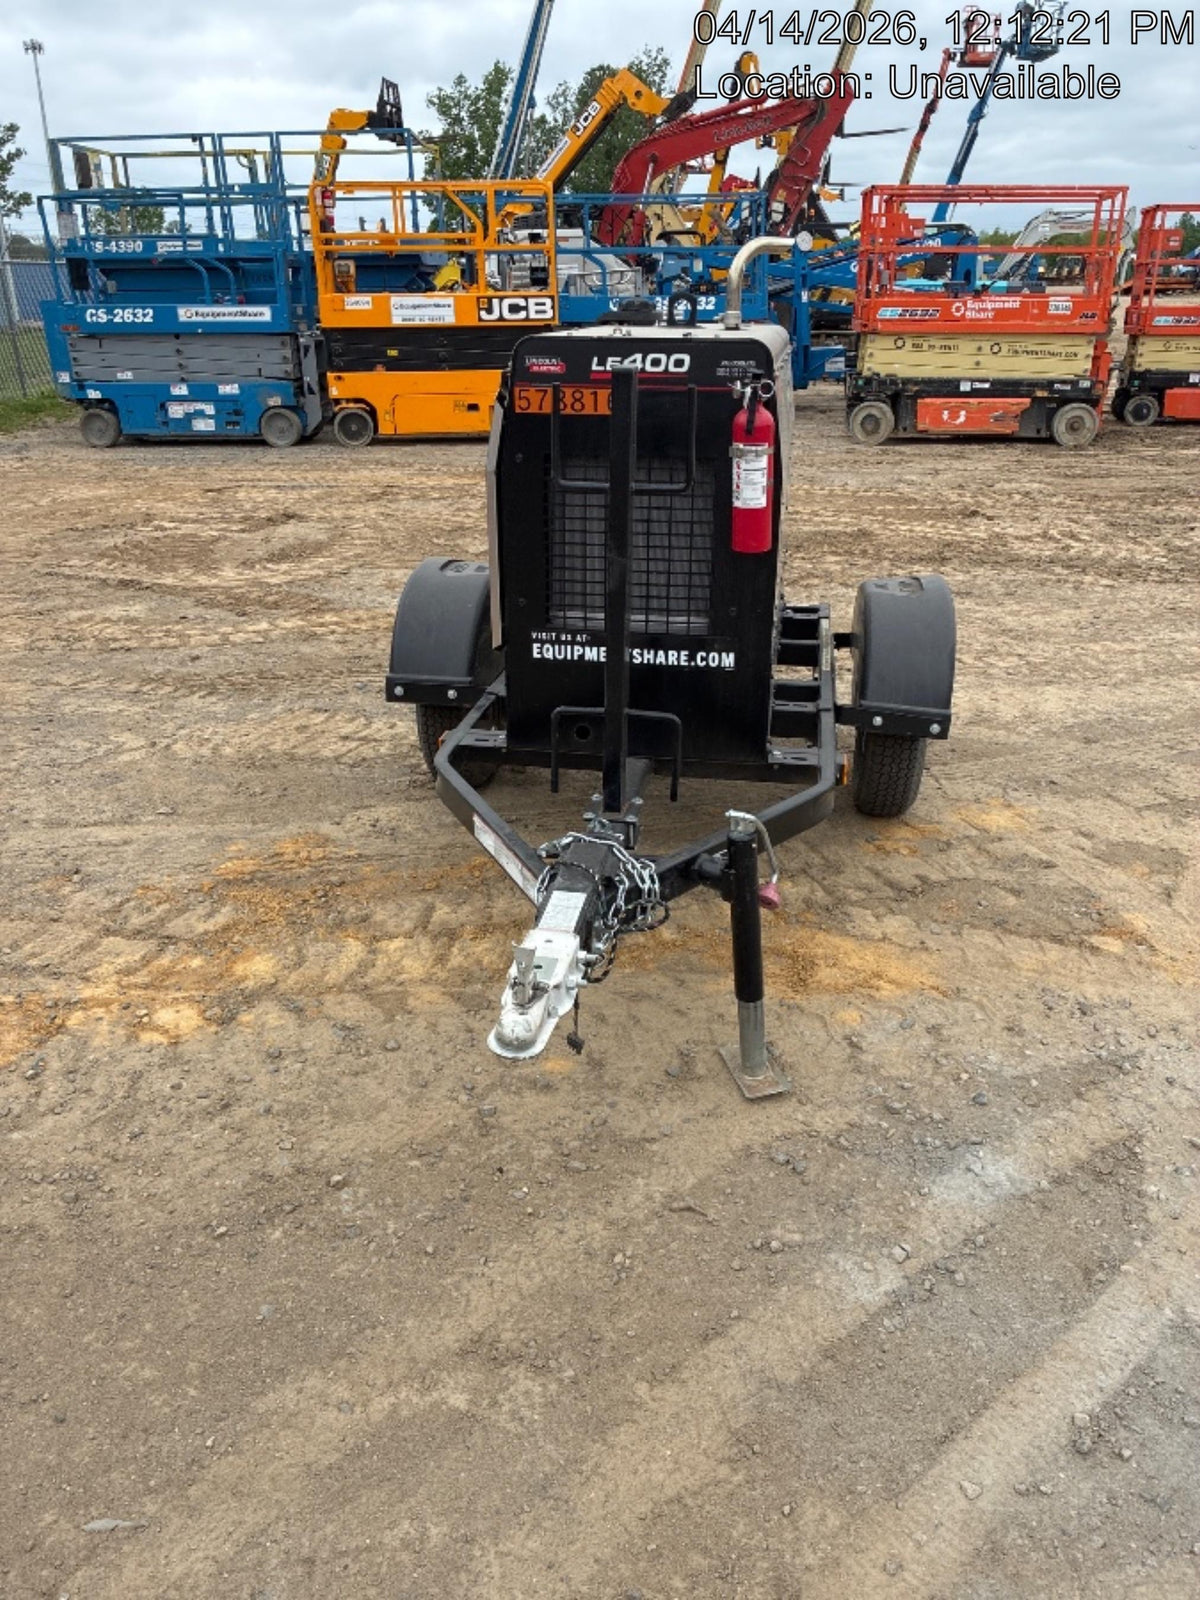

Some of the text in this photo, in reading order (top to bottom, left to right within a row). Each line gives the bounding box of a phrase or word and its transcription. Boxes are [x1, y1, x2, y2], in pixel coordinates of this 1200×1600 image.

[575, 101, 601, 136] JCB
[479, 297, 554, 321] JCB
[966, 299, 1021, 310] Equipment
[86, 308, 154, 323] GS-2632
[591, 353, 691, 372] LE400
[531, 632, 556, 641] VISIT
[532, 643, 735, 668] EQUIPMESHARE.COM
